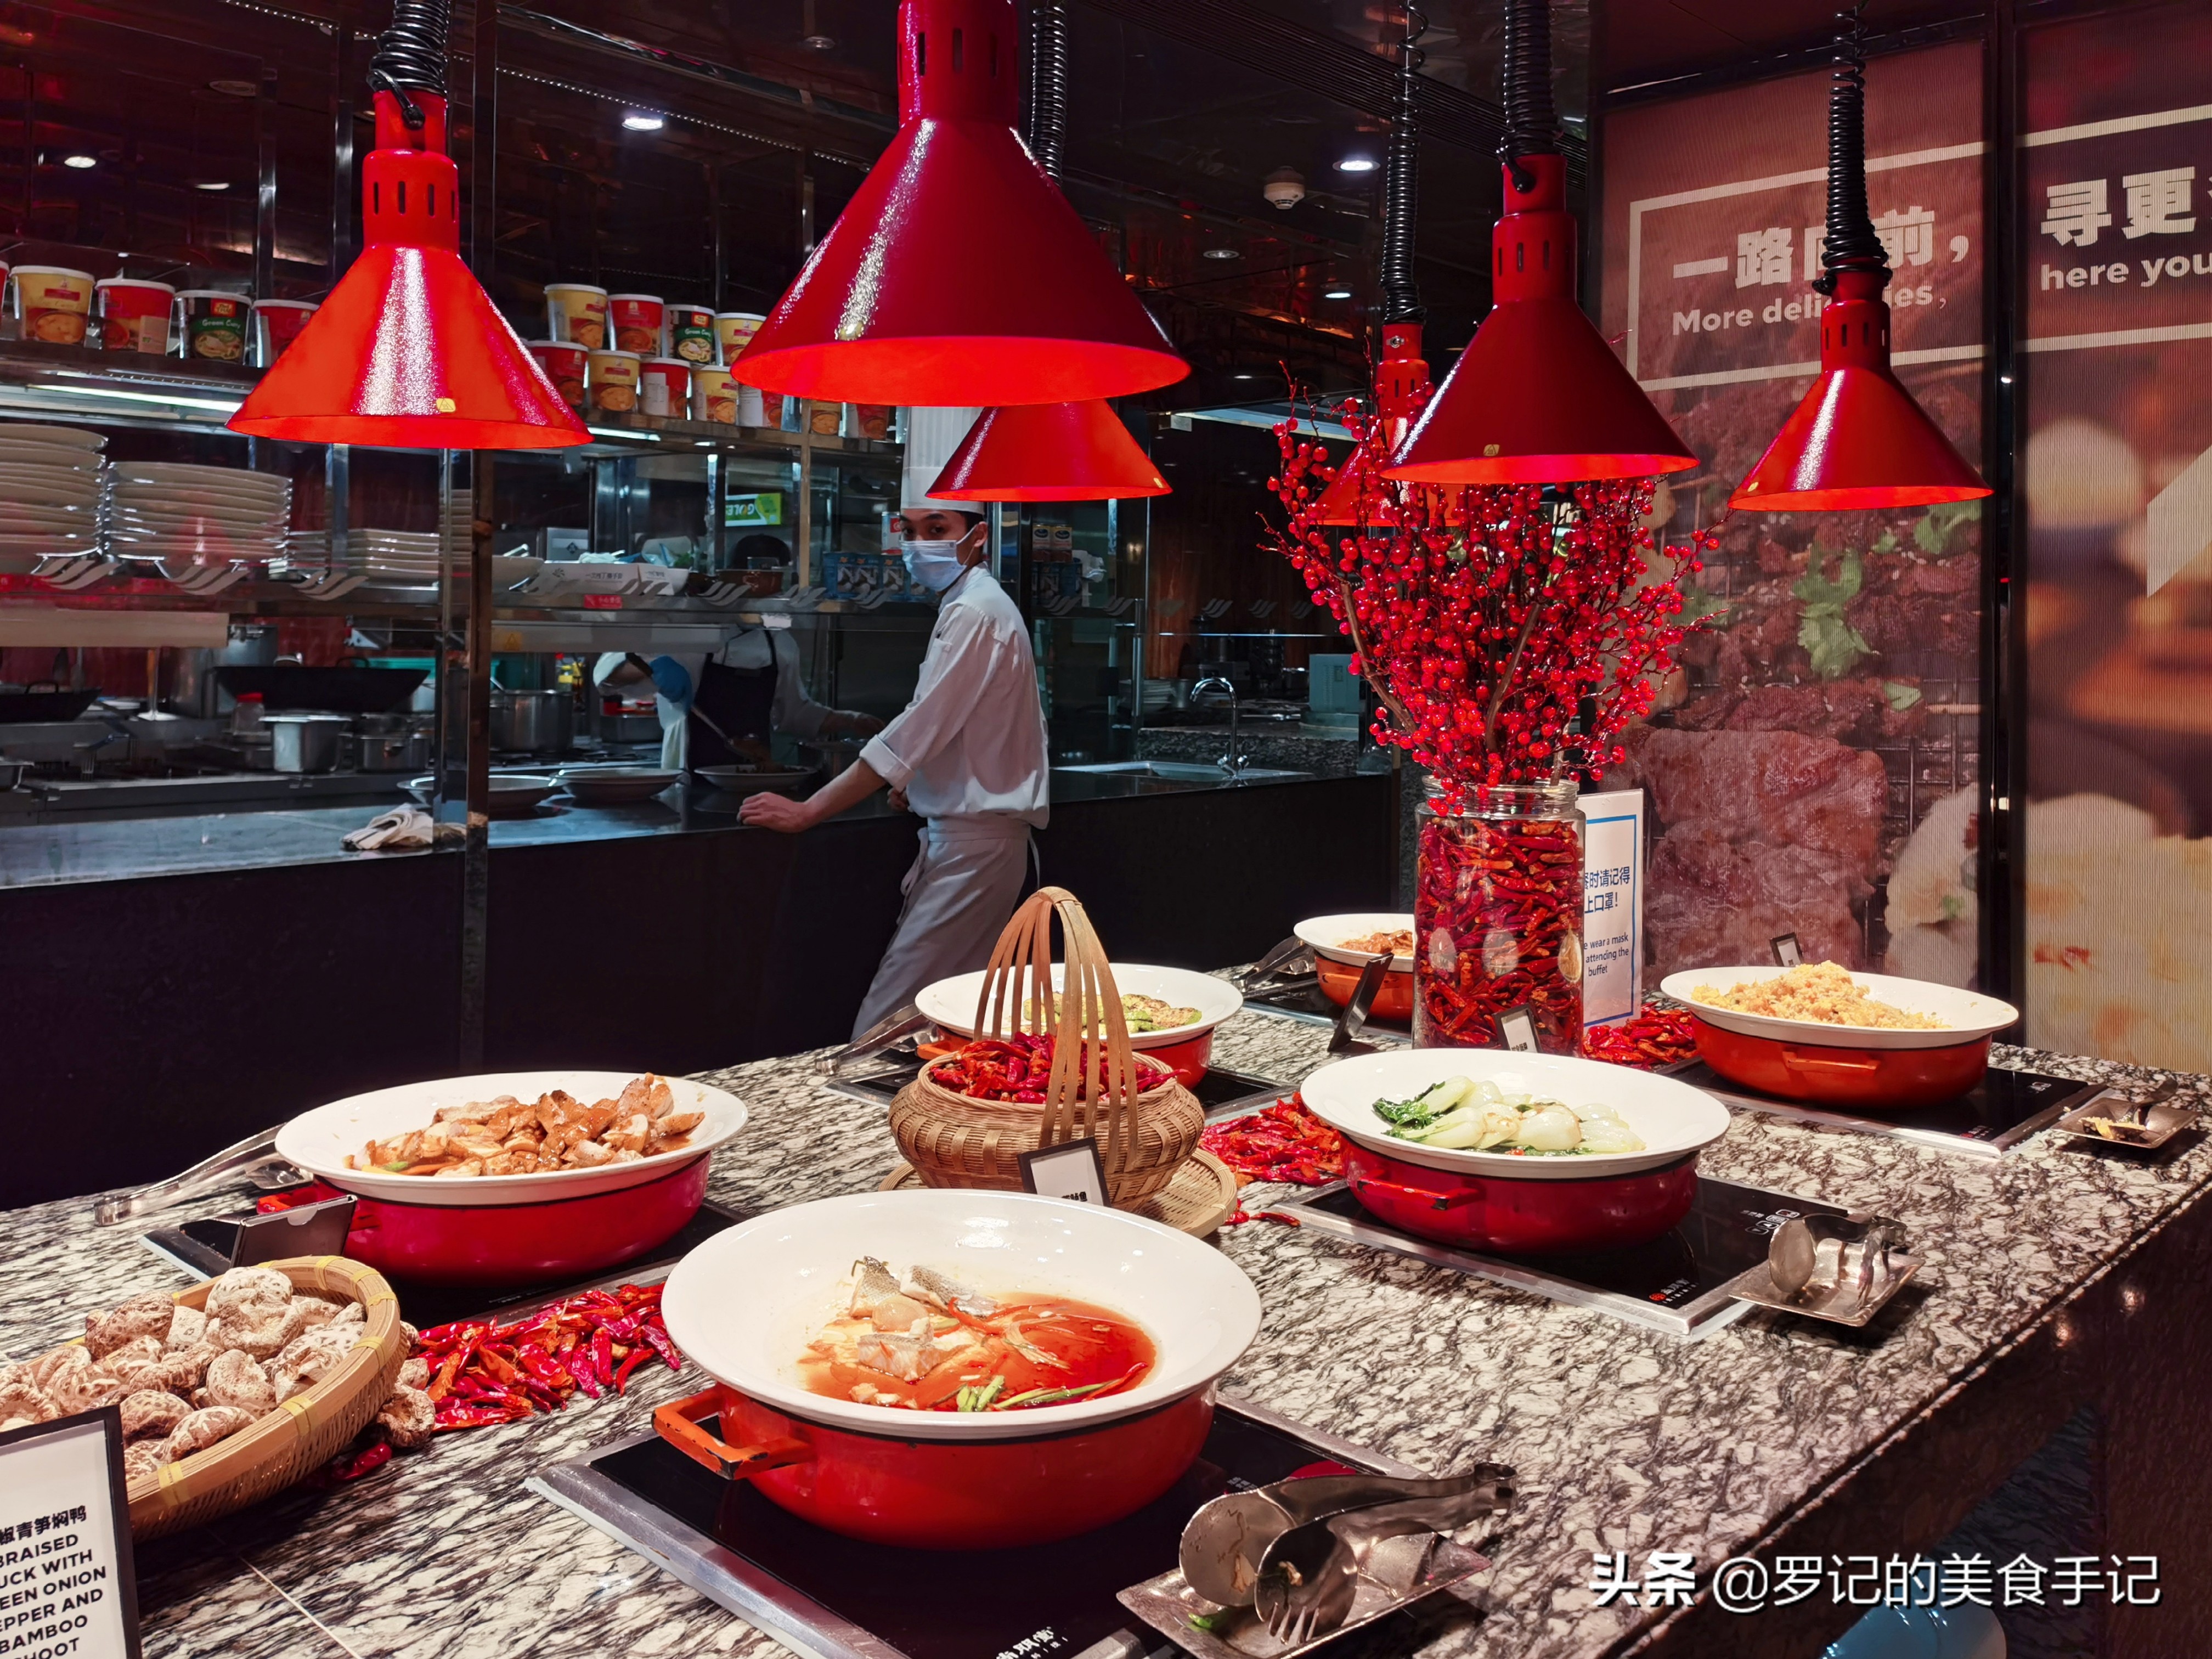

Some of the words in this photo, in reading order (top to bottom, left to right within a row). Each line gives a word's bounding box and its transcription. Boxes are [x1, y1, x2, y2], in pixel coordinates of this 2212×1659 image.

[2041, 166, 2212, 247] 寻更
[2041, 262, 2129, 291] here
[1673, 308, 1754, 336] More
[1589, 938, 1606, 949] wear
[1606, 937, 1610, 945] a
[1611, 932, 1629, 945] mask
[1585, 950, 1617, 963] attending
[1618, 946, 1629, 957] the
[1588, 964, 1608, 977] buffet
[41, 1549, 93, 1575] WITH
[0, 1587, 38, 1610] EEN
[43, 1566, 106, 1595] ONION
[61, 1588, 103, 1613] AND
[0, 1615, 87, 1655] BAMBOO
[14, 1637, 80, 1659] OOT
